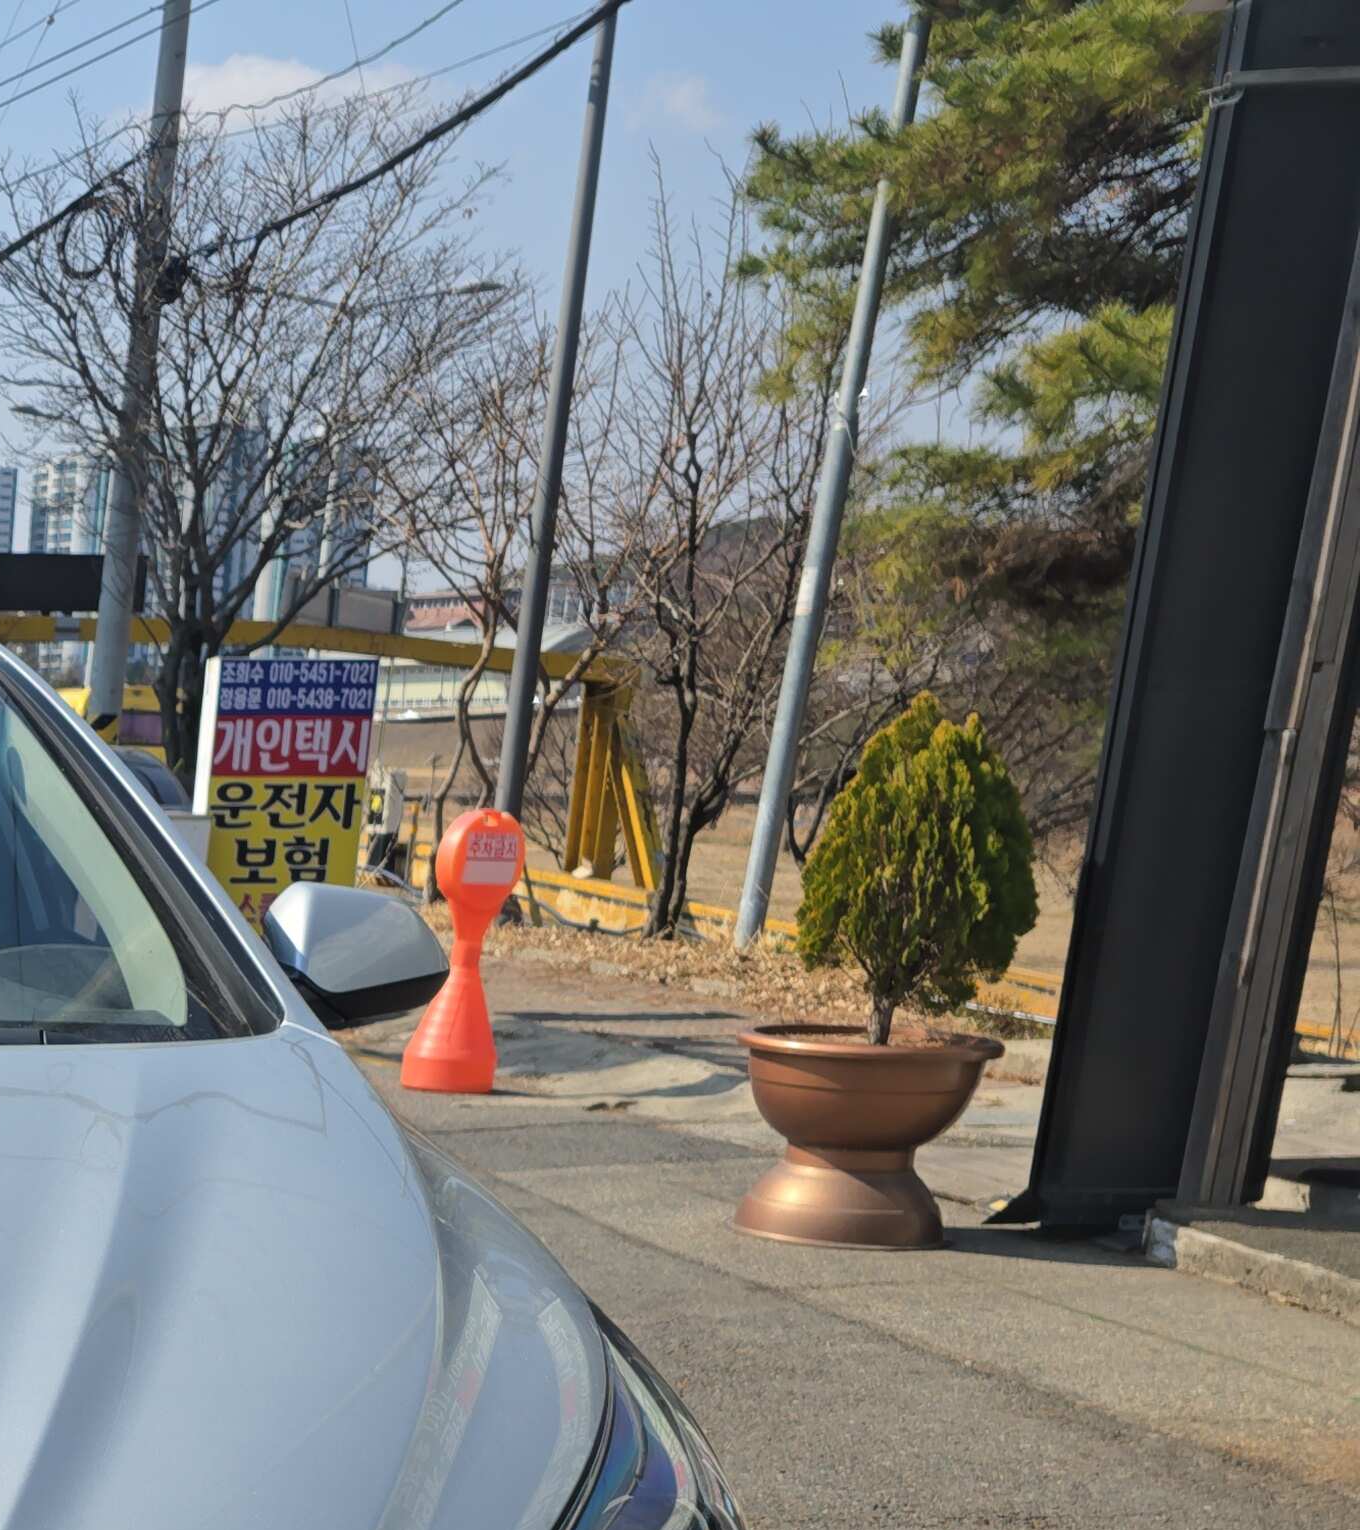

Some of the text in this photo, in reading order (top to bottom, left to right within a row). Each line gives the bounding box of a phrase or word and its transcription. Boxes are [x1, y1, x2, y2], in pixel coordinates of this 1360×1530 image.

[269, 662, 376, 684] 010-5451-7021
[214, 718, 369, 773] 개인택시
[210, 782, 362, 829] 운전자
[230, 836, 330, 883] 보험
